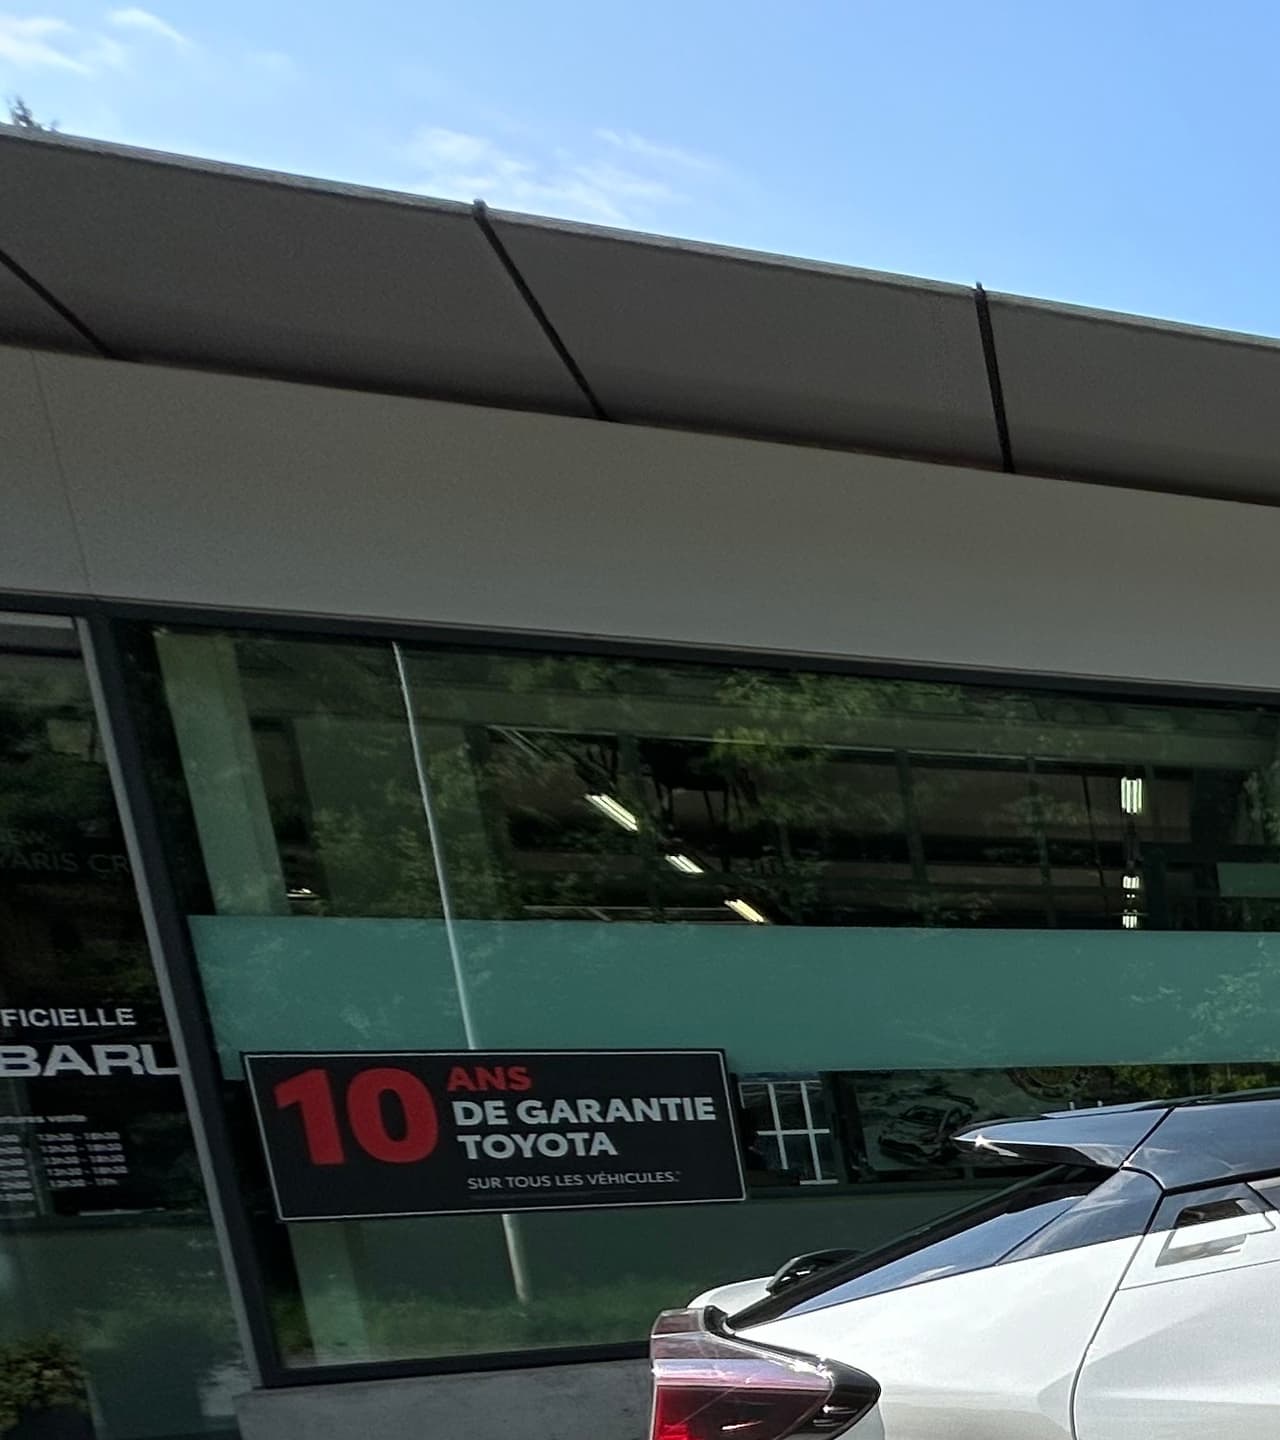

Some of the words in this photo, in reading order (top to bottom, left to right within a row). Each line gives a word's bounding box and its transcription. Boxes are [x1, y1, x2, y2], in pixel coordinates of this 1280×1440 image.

[0, 1008, 137, 1027] FICIELLE
[447, 1066, 532, 1091] ANS
[273, 1067, 438, 1165] 10
[452, 1100, 510, 1126] DE
[516, 1097, 717, 1125] GARANTIE
[457, 1132, 619, 1160] TOYOTA
[467, 1177, 503, 1190] SUR
[505, 1174, 551, 1189] TOUS
[555, 1173, 584, 1187] LES
